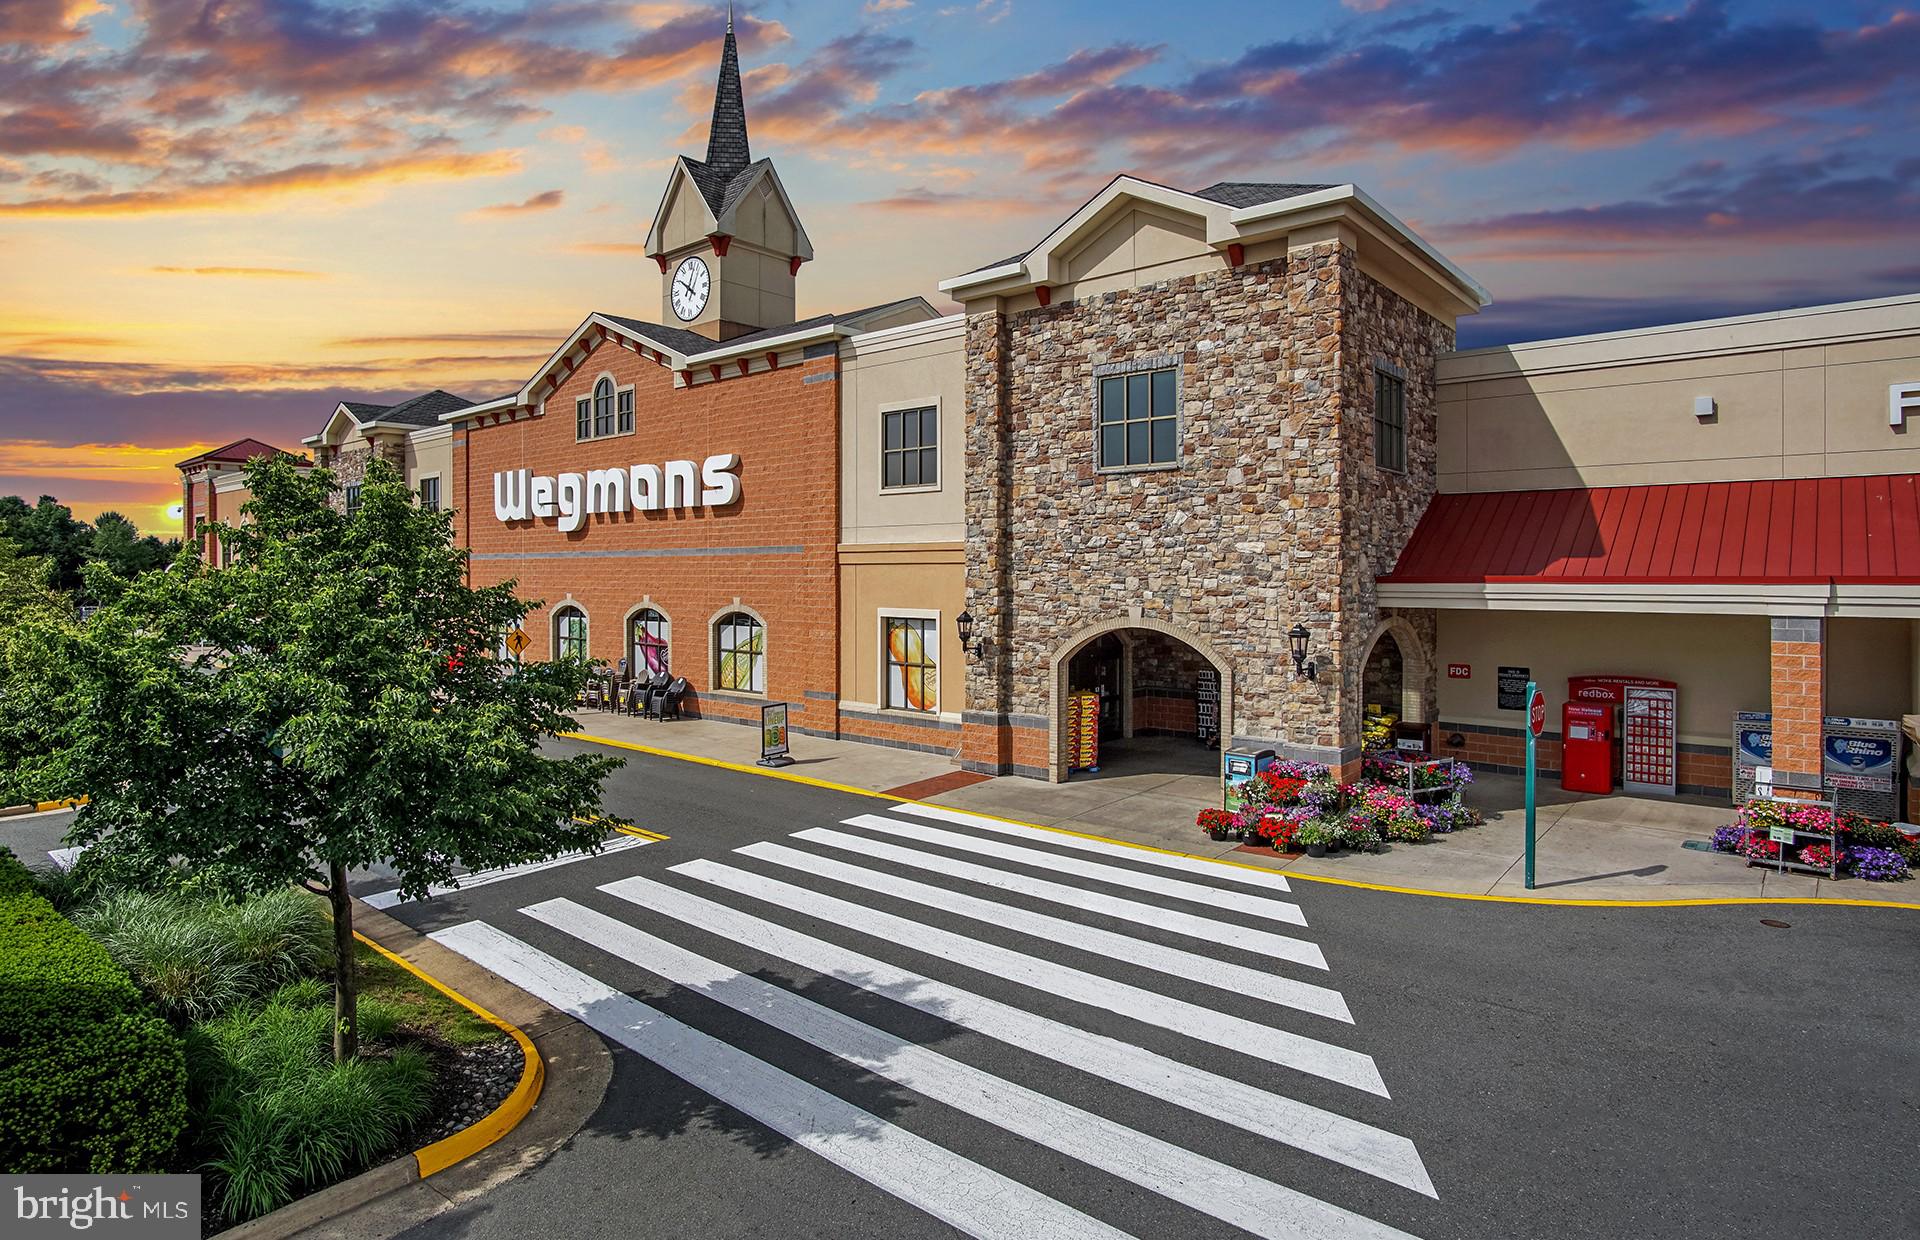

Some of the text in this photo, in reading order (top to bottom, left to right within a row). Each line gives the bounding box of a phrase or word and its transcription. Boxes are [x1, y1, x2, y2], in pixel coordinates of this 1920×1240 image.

[494, 454, 740, 532] Wegmans
[1450, 667, 1469, 676] FDC
[1578, 688, 1615, 699] redbox
[1531, 705, 1545, 724] STOP
[1848, 740, 1877, 748] Blue
[1846, 746, 1884, 756] Rhino
